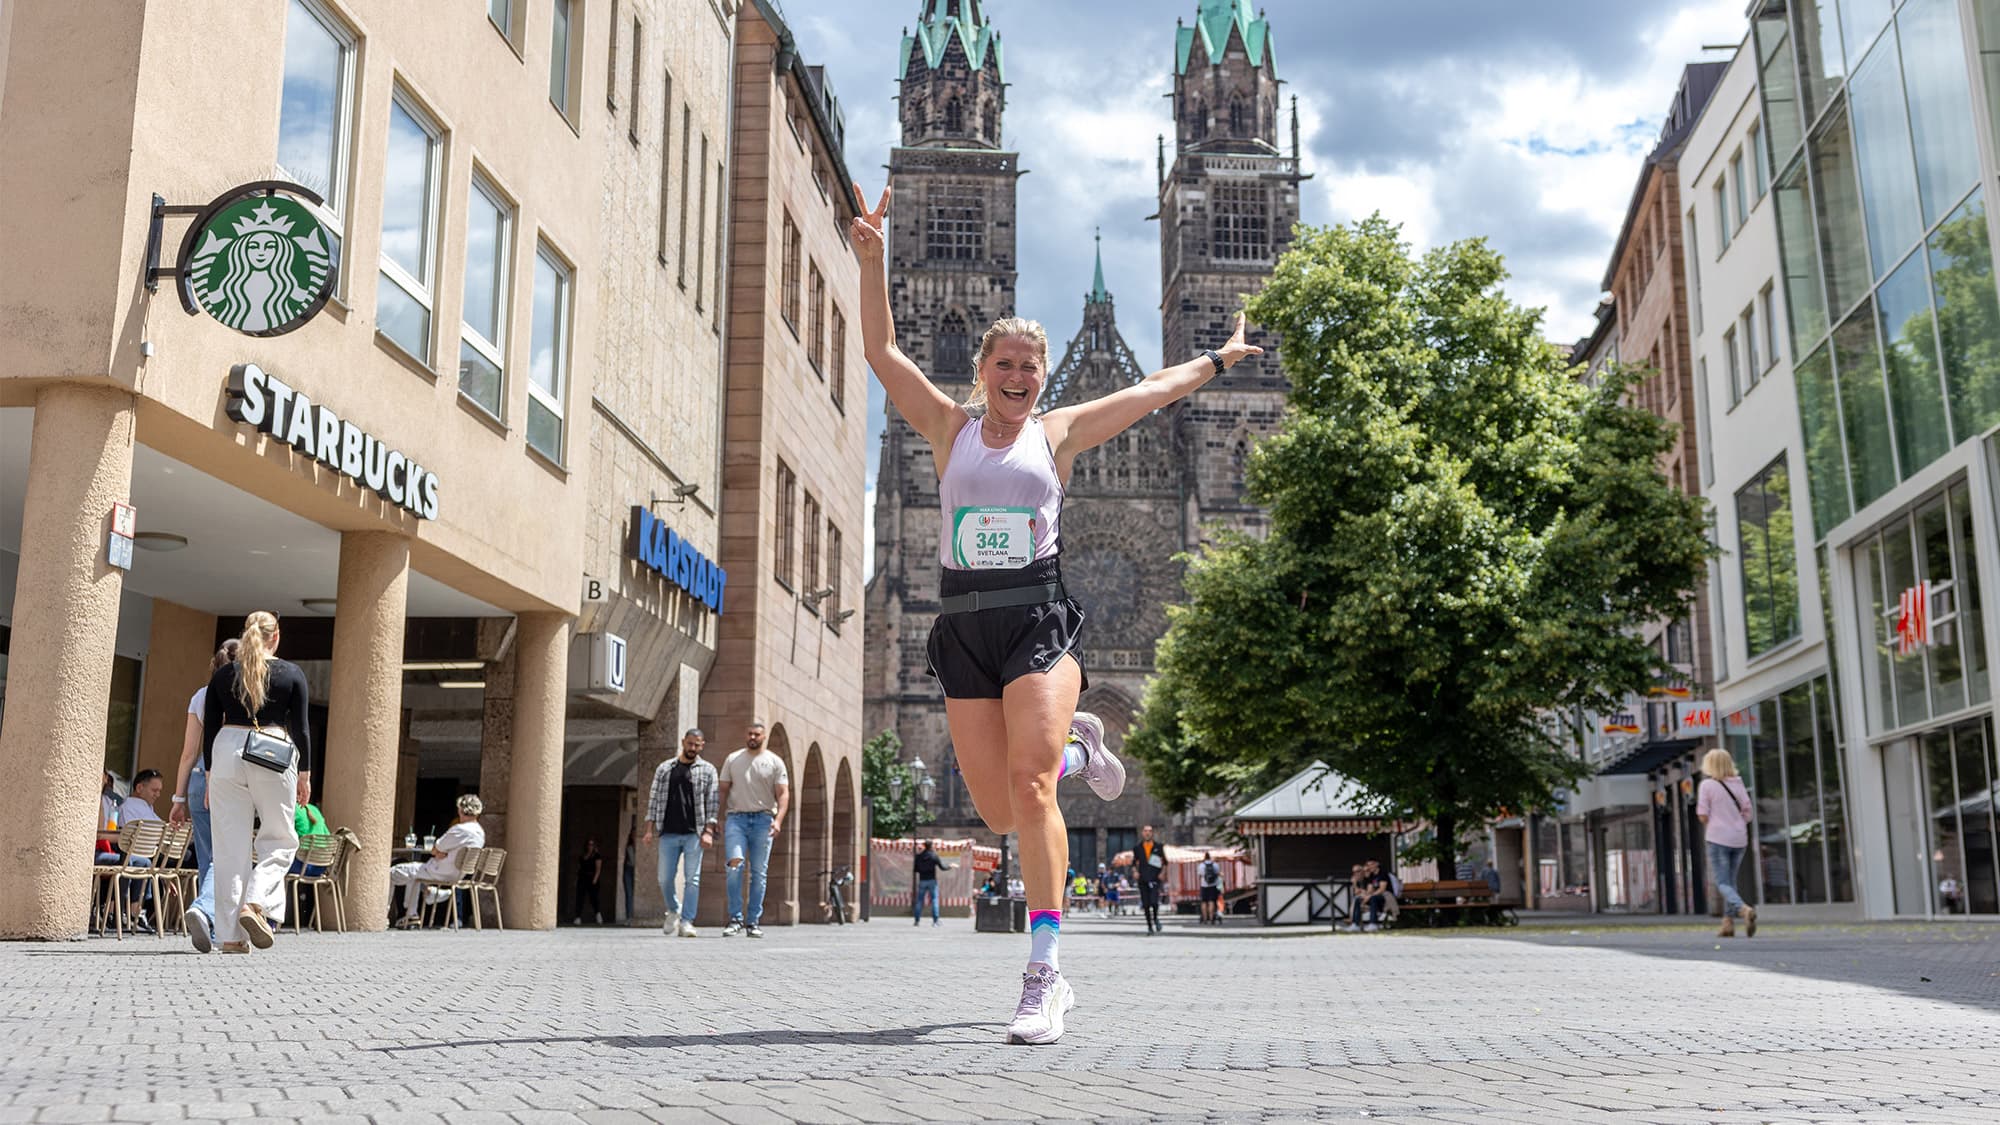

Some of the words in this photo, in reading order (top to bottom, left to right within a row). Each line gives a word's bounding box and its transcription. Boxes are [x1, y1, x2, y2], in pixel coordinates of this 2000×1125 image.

[240, 364, 439, 521] STARBUCKS
[976, 532, 1010, 549] 342
[639, 506, 727, 616] KARSTADT
[588, 580, 602, 600] B
[611, 641, 625, 687] U
[1609, 712, 1634, 725] dm
